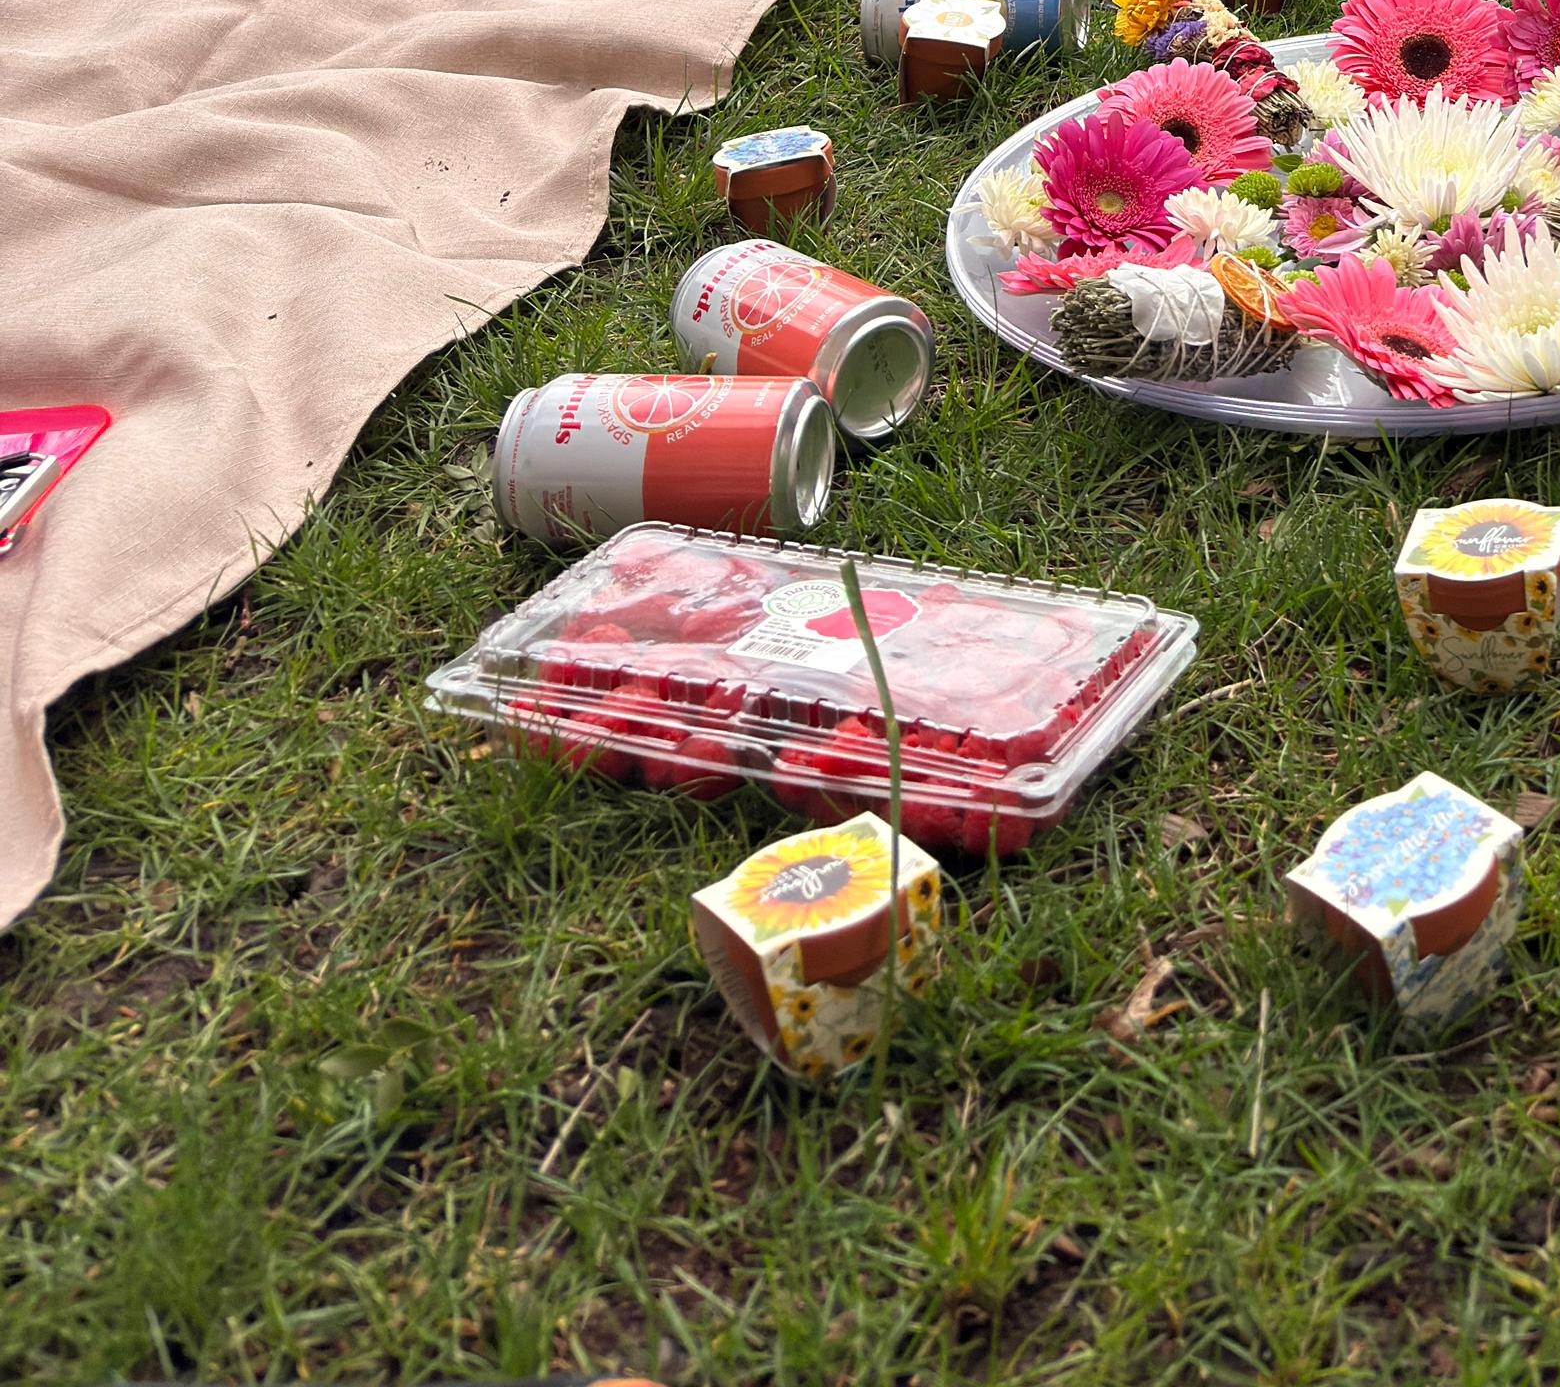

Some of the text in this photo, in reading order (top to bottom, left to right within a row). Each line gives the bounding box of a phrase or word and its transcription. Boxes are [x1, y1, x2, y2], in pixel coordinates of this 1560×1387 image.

[750, 331, 775, 348] REAL
[555, 374, 598, 445] spindr
[665, 419, 703, 444] REAL
[1440, 525, 1535, 553] Sunflower
[783, 584, 840, 601] naturipe
[1441, 635, 1525, 673] Sunflower
